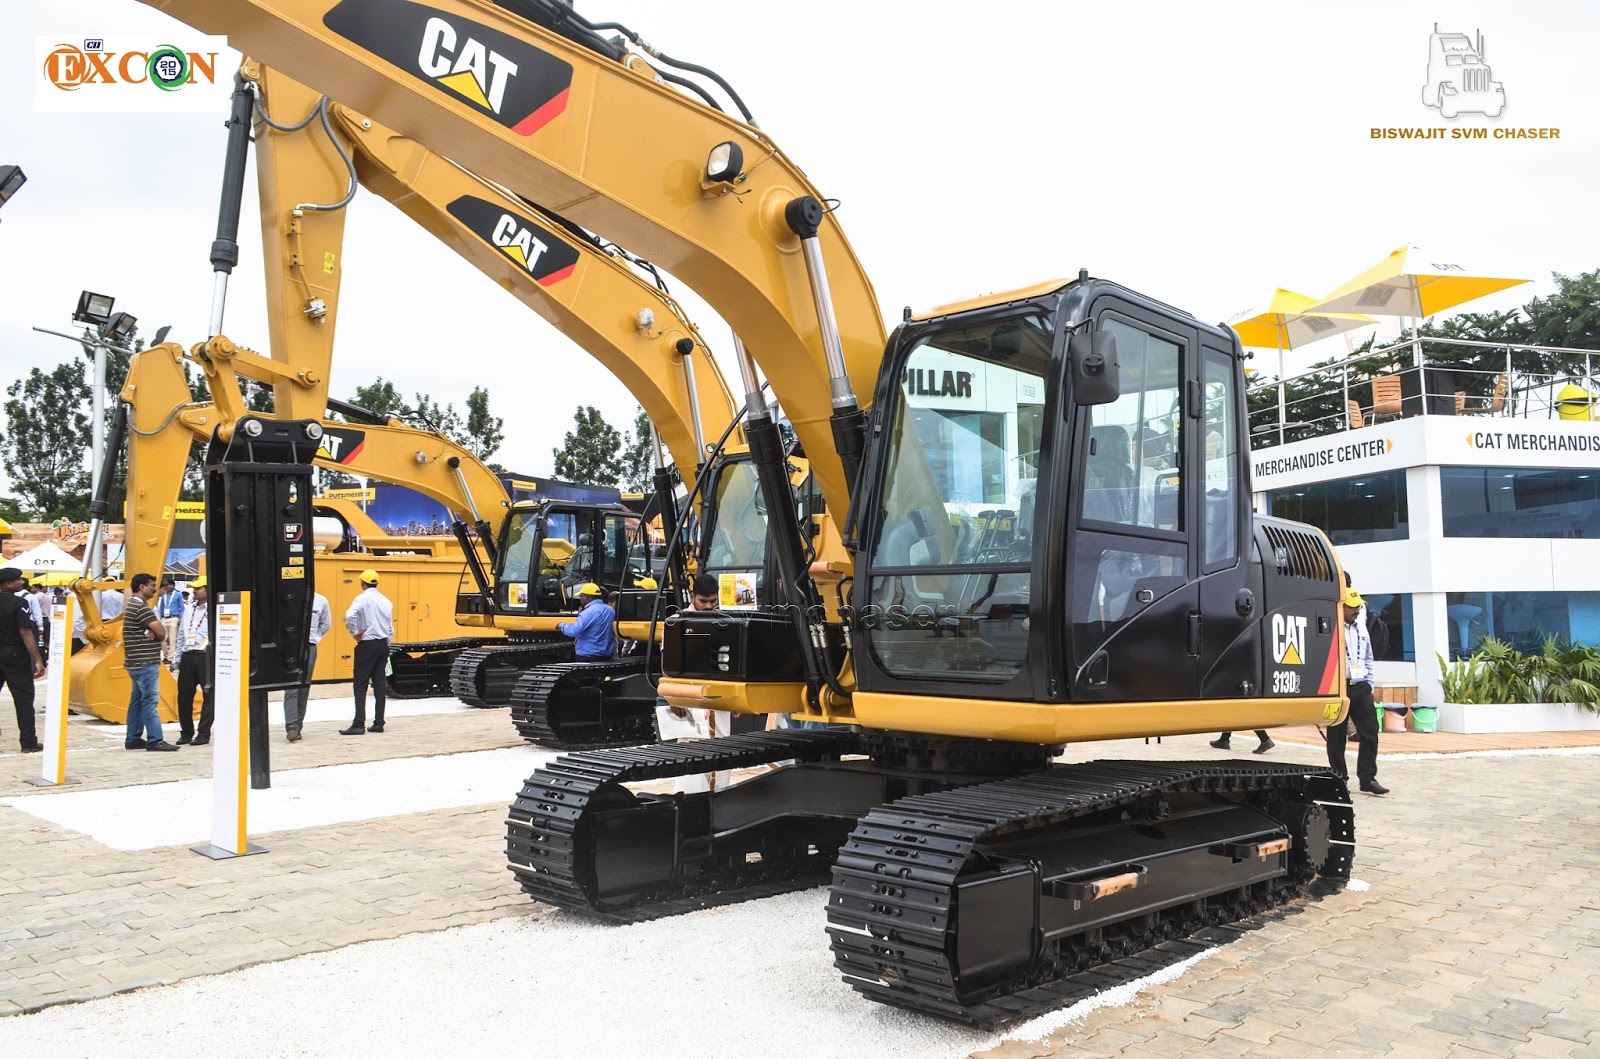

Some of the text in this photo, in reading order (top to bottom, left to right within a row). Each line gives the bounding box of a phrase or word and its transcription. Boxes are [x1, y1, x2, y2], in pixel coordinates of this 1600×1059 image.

[418, 17, 519, 115] CAT
[492, 213, 549, 273] CAT
[1255, 438, 1385, 478] MERCHANDISE CENTER
[1475, 432, 1600, 452] CAT MERCHANDIS
[1272, 613, 1308, 665] CAT
